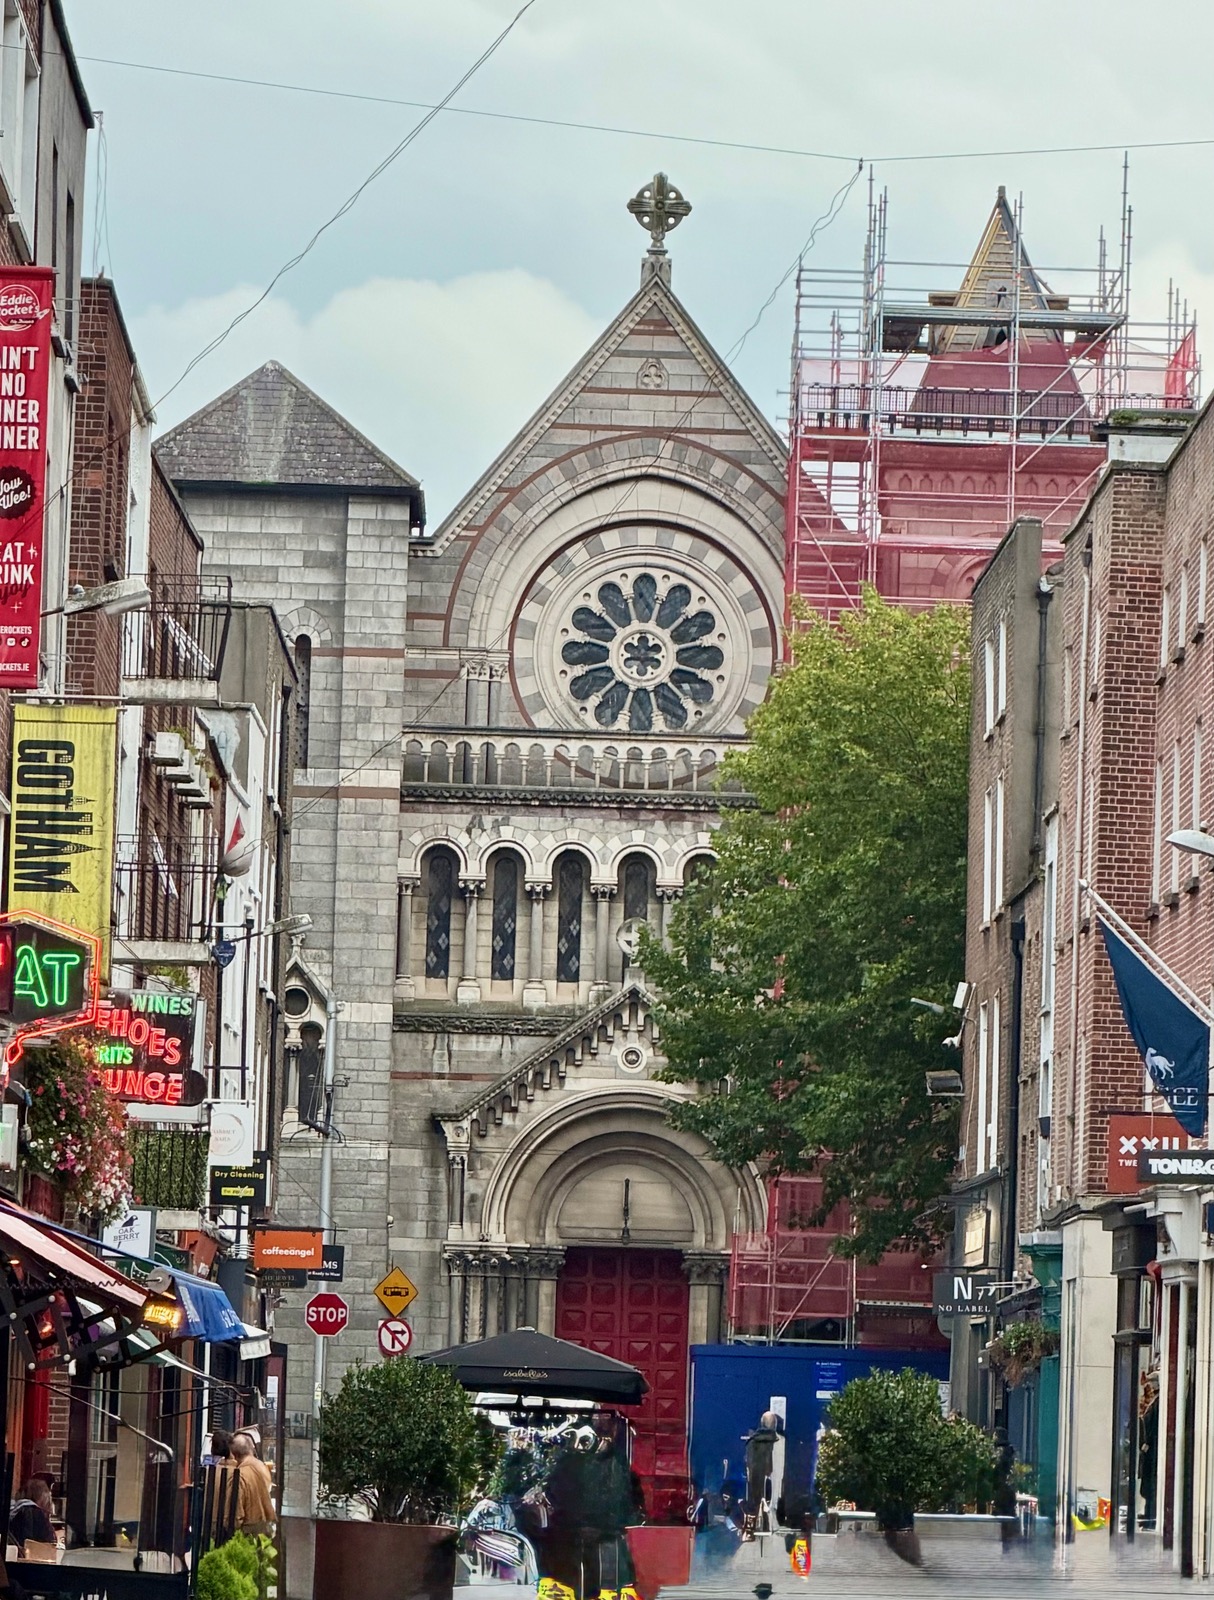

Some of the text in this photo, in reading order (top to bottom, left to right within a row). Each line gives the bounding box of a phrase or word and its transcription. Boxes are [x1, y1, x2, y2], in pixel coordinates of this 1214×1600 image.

[0, 294, 33, 305] Eddie
[0, 303, 40, 316] ocket's
[0, 346, 39, 370] IN'T
[1, 373, 26, 397] NO
[0, 399, 40, 423] NER
[0, 426, 40, 450] NER
[0, 542, 24, 563] AT
[0, 626, 32, 635] EROCKETS
[14, 739, 101, 893] GOTHAM
[131, 994, 193, 1016] WINES
[94, 1008, 181, 1065] EHOES
[97, 1045, 134, 1064] RITS
[103, 1069, 183, 1104] UNGE
[1118, 1159, 1138, 1167] TWE
[215, 1171, 265, 1180] Dry Cleaning
[113, 1232, 140, 1242] BERRY
[118, 1227, 135, 1235] OAK
[262, 1246, 315, 1258] coffeeangel
[322, 1260, 338, 1270] MS
[308, 1307, 346, 1322] STOP
[938, 1304, 991, 1313] NO LABEL
